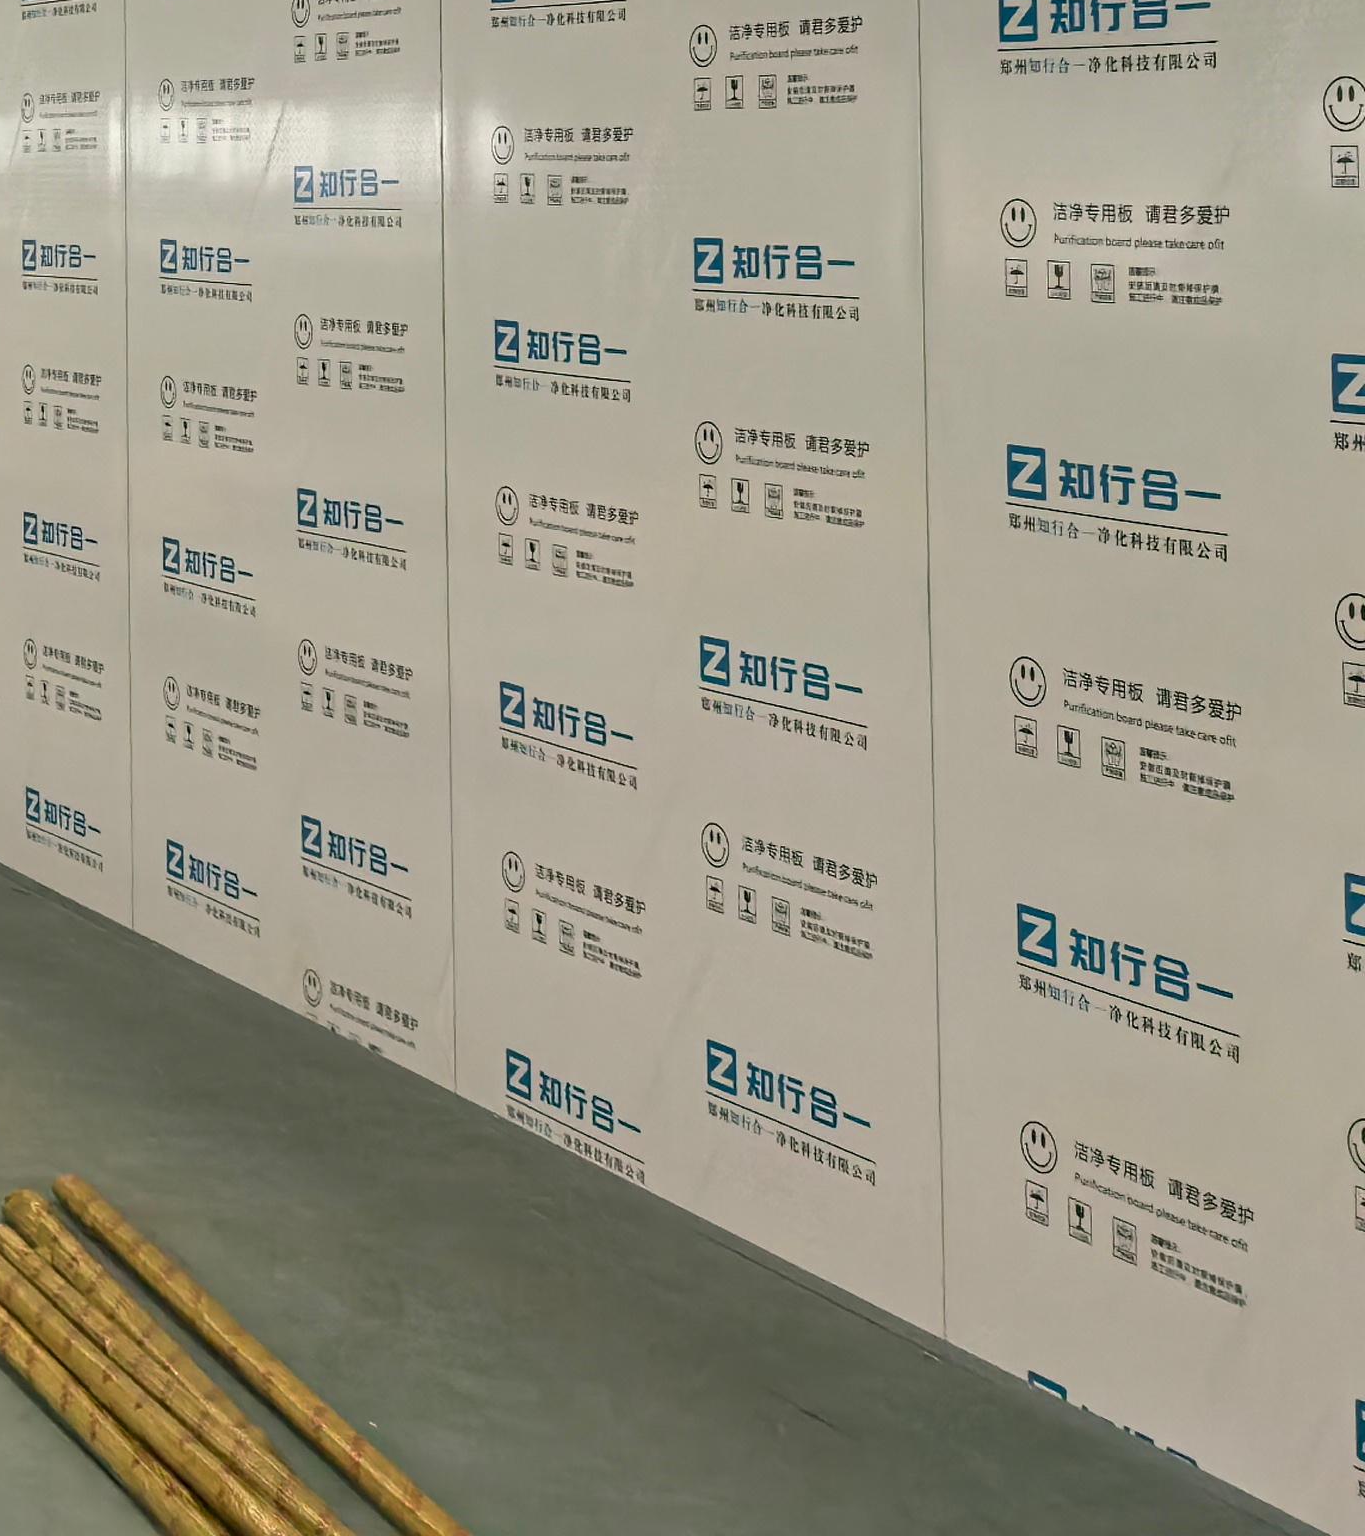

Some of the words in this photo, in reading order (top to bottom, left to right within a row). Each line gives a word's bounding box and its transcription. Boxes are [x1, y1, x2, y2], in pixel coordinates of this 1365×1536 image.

[1053, 202, 1134, 224] 洁净专用板
[1145, 204, 1232, 227] 请君多爱护
[733, 244, 855, 281] 知行合一
[526, 329, 626, 366] 知行合一
[1059, 458, 1221, 513] 知行合一
[739, 649, 863, 703] 知行合一
[1063, 667, 1144, 704] 洁净专用板
[1156, 687, 1244, 725] 请君多爱护
[532, 696, 633, 748] 知行合一
[1070, 927, 1234, 1005] 知行合一
[539, 1070, 640, 1136] 知行合一
[746, 1060, 871, 1132] 知行合一
[1074, 1139, 1157, 1192] 洁净专用板
[1168, 1177, 1257, 1233] 请君多爱护
